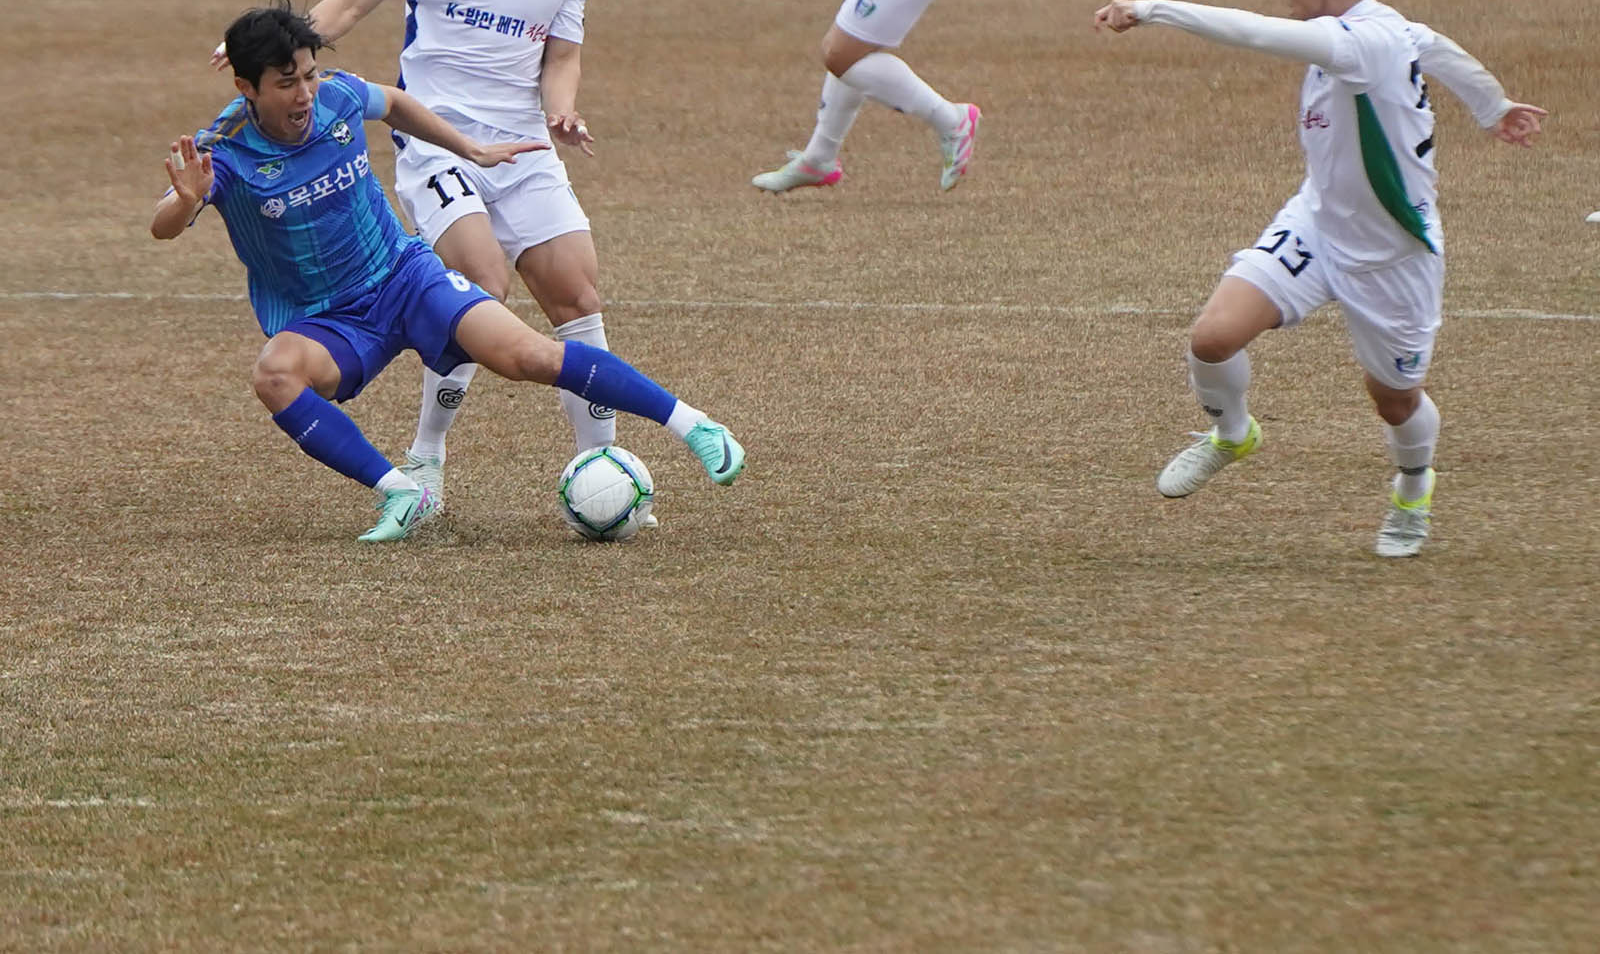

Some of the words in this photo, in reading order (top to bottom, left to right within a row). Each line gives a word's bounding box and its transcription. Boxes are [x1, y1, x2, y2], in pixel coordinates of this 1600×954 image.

[496, 15, 526, 38] 메카
[288, 149, 369, 207] 목포신협
[427, 166, 476, 209] 11
[446, 271, 471, 292] 6
